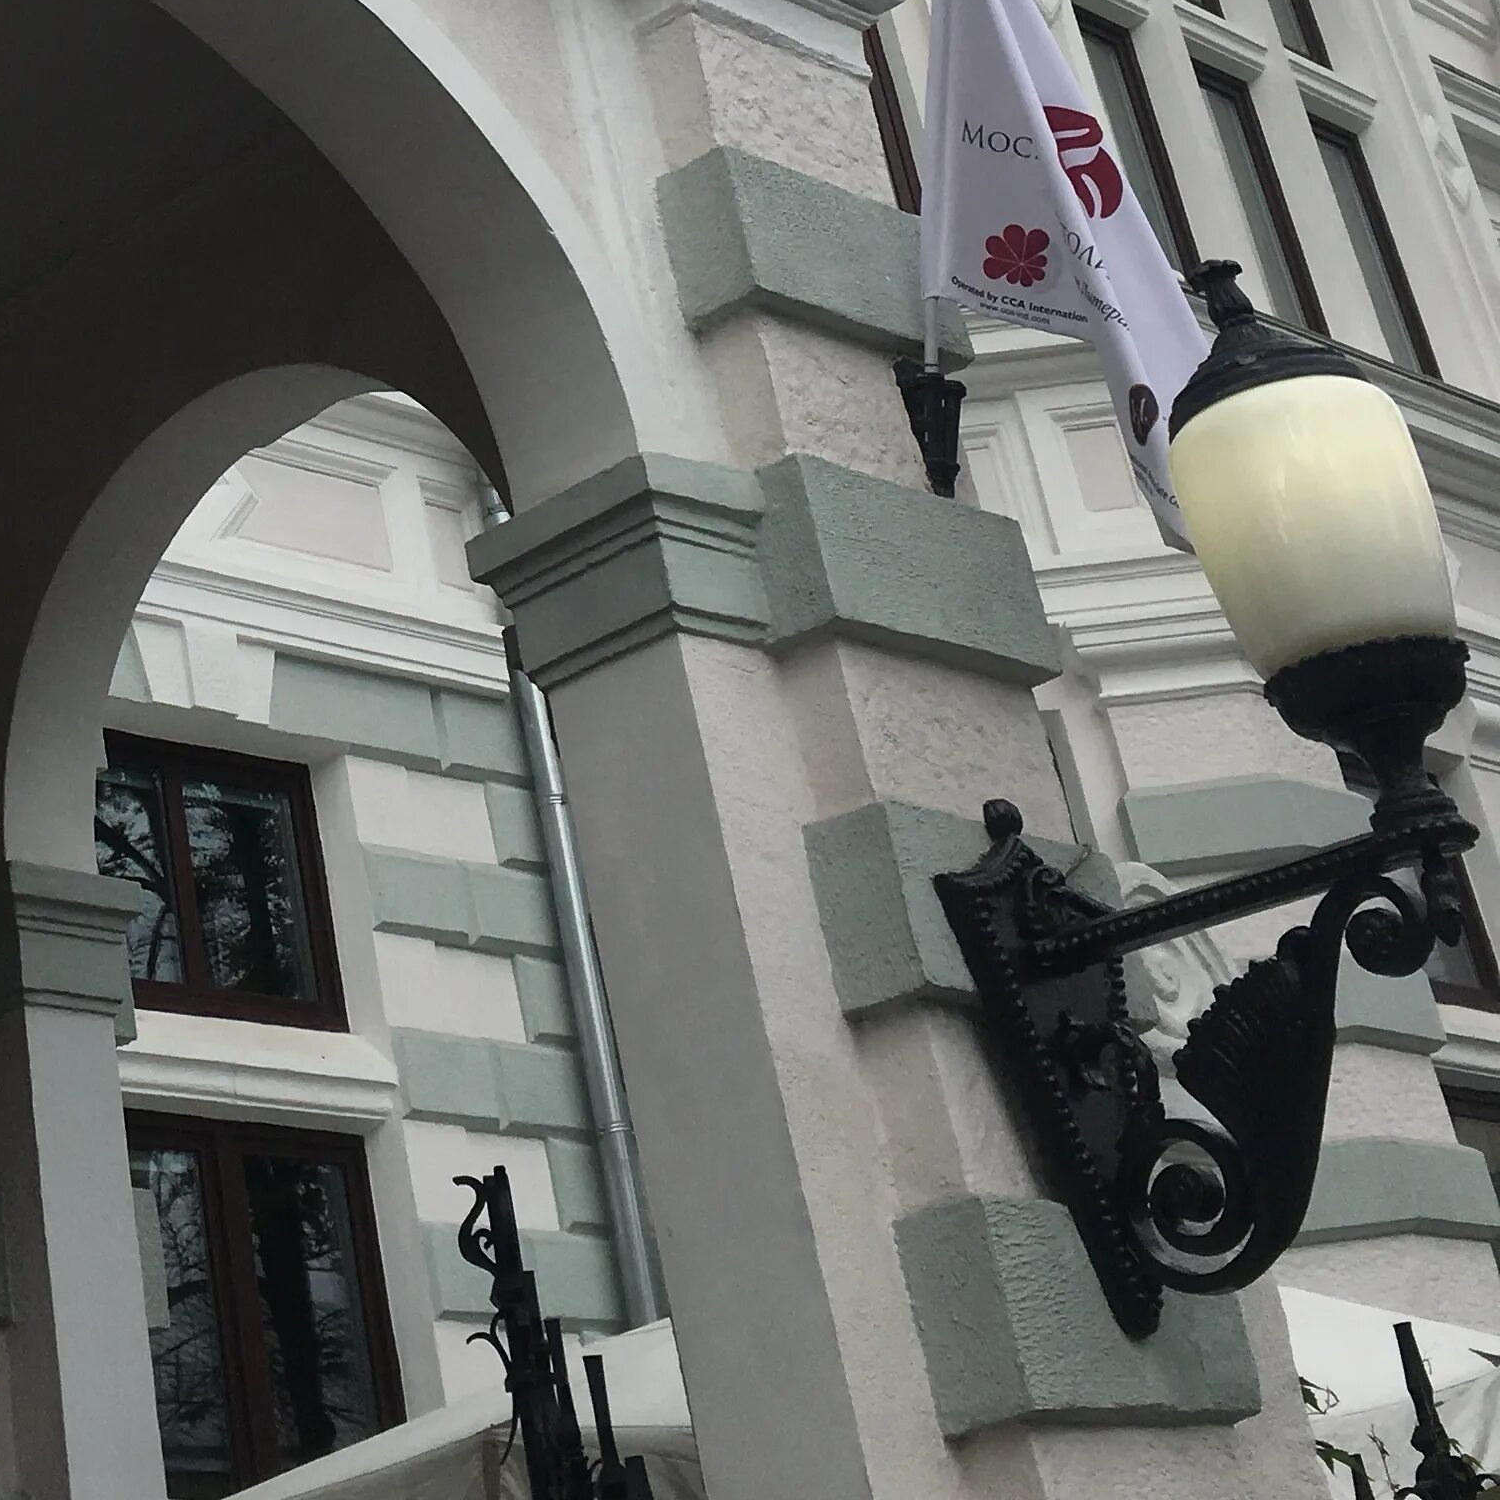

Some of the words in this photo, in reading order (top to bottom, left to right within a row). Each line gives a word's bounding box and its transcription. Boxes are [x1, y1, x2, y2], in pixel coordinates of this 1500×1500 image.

[951, 274, 986, 299] Operated
[986, 290, 999, 304] by
[1001, 295, 1026, 310] CCA
